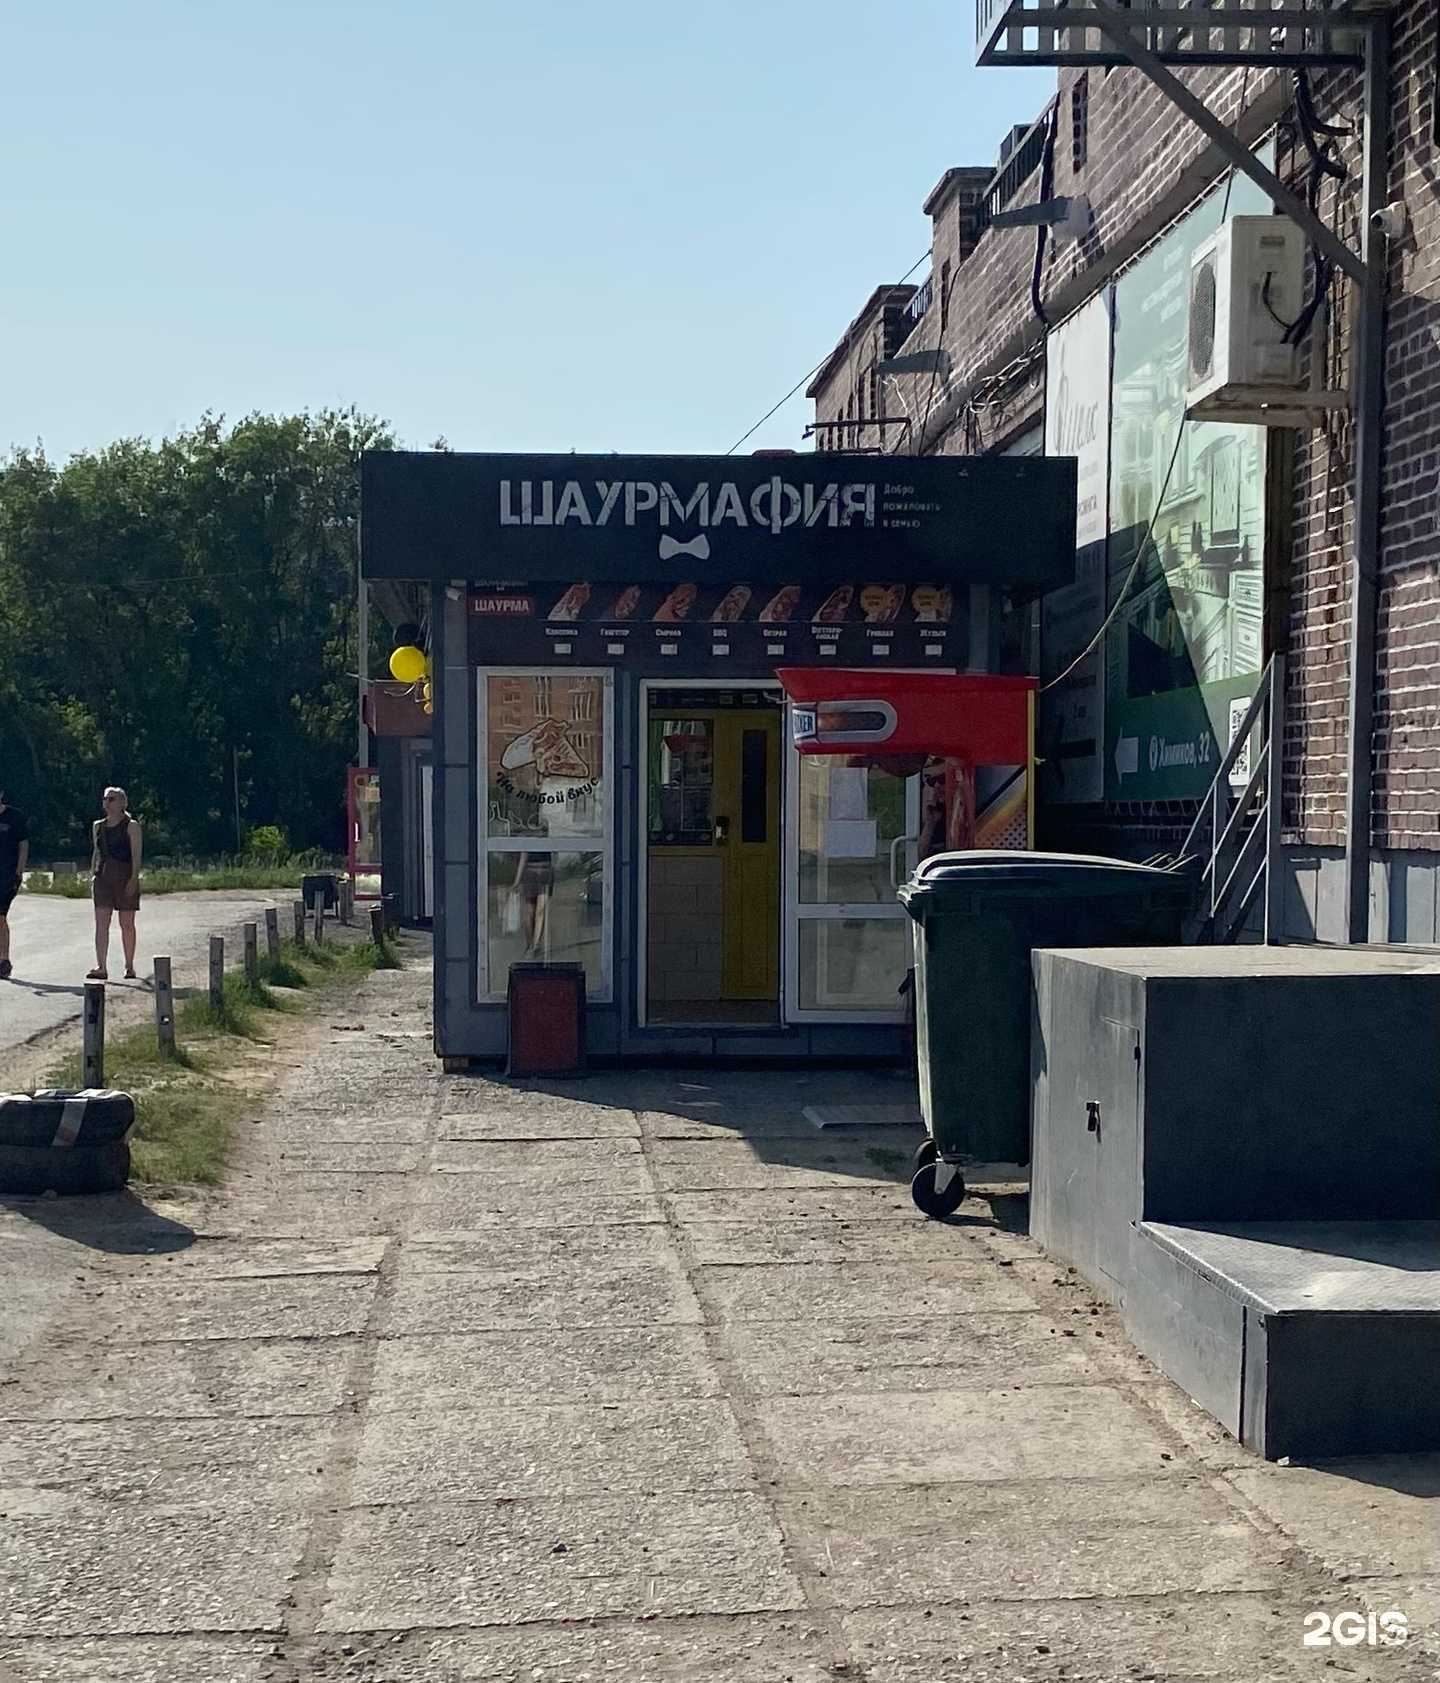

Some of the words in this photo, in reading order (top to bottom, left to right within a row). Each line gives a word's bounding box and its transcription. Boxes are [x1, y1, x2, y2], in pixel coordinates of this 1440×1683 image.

[499, 477, 876, 534] ШАУРМАФИЯ
[883, 483, 914, 496] Добро
[474, 599, 529, 612] ШАУРМА
[1198, 731, 1210, 764] 32
[496, 771, 514, 794] На
[516, 790, 565, 805] любой
[567, 776, 600, 801] вкус
